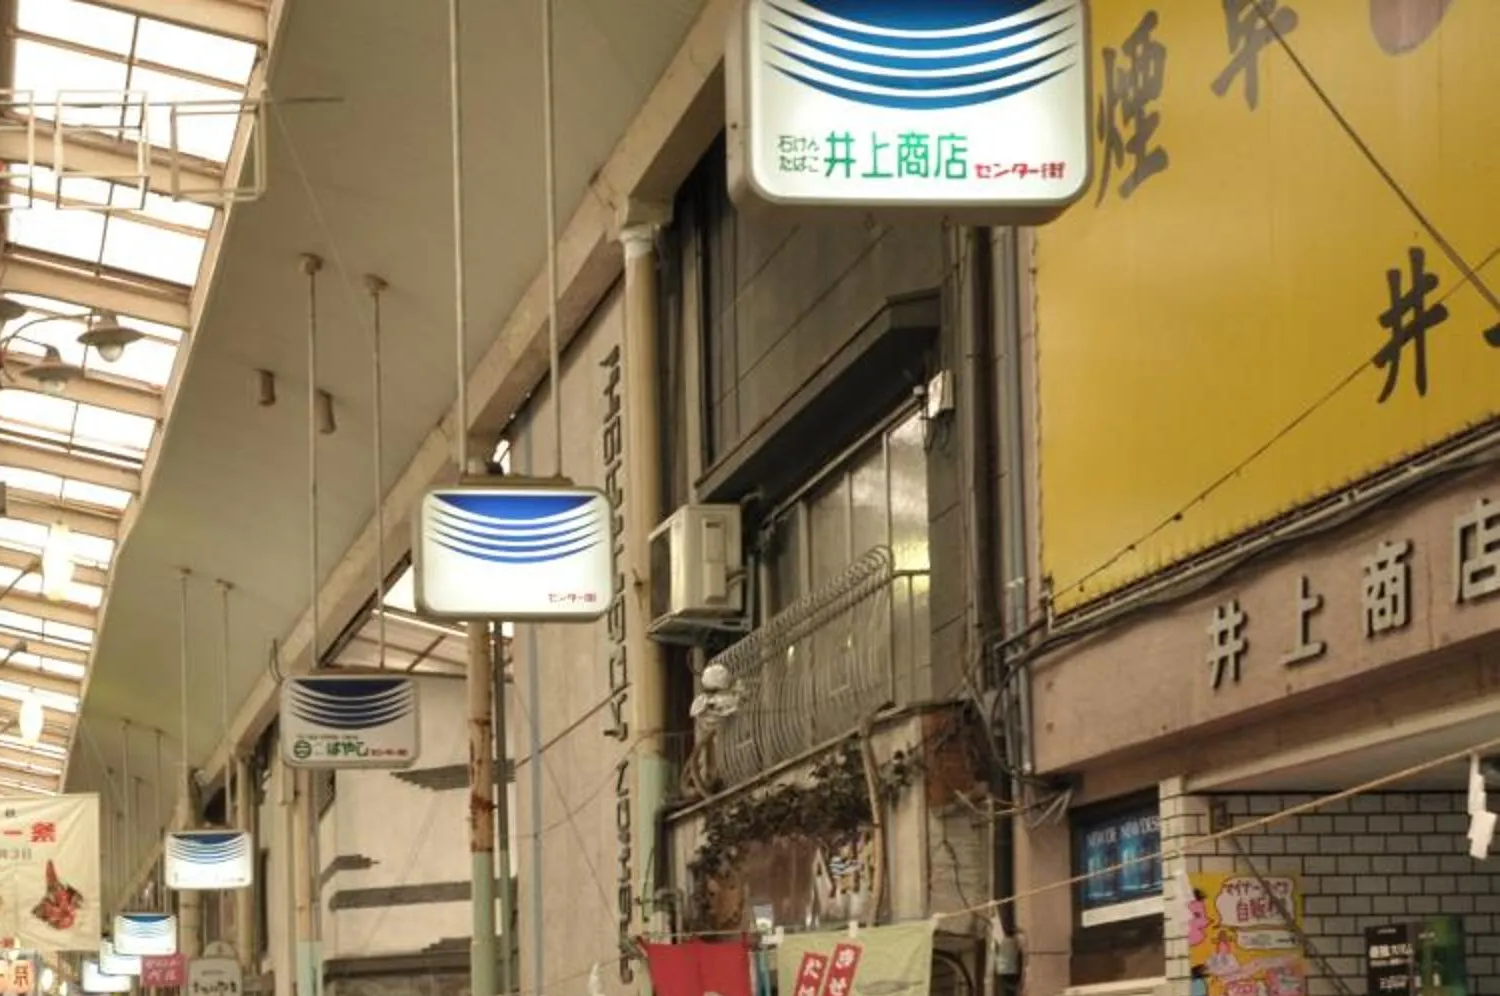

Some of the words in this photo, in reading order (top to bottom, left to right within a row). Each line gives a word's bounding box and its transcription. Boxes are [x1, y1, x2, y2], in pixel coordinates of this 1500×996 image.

[777, 135, 820, 153] 石けん
[823, 132, 969, 180] 井上商店
[974, 161, 1066, 181] センター街
[777, 154, 820, 173] たばこ
[1205, 497, 1500, 692] 井上商店
